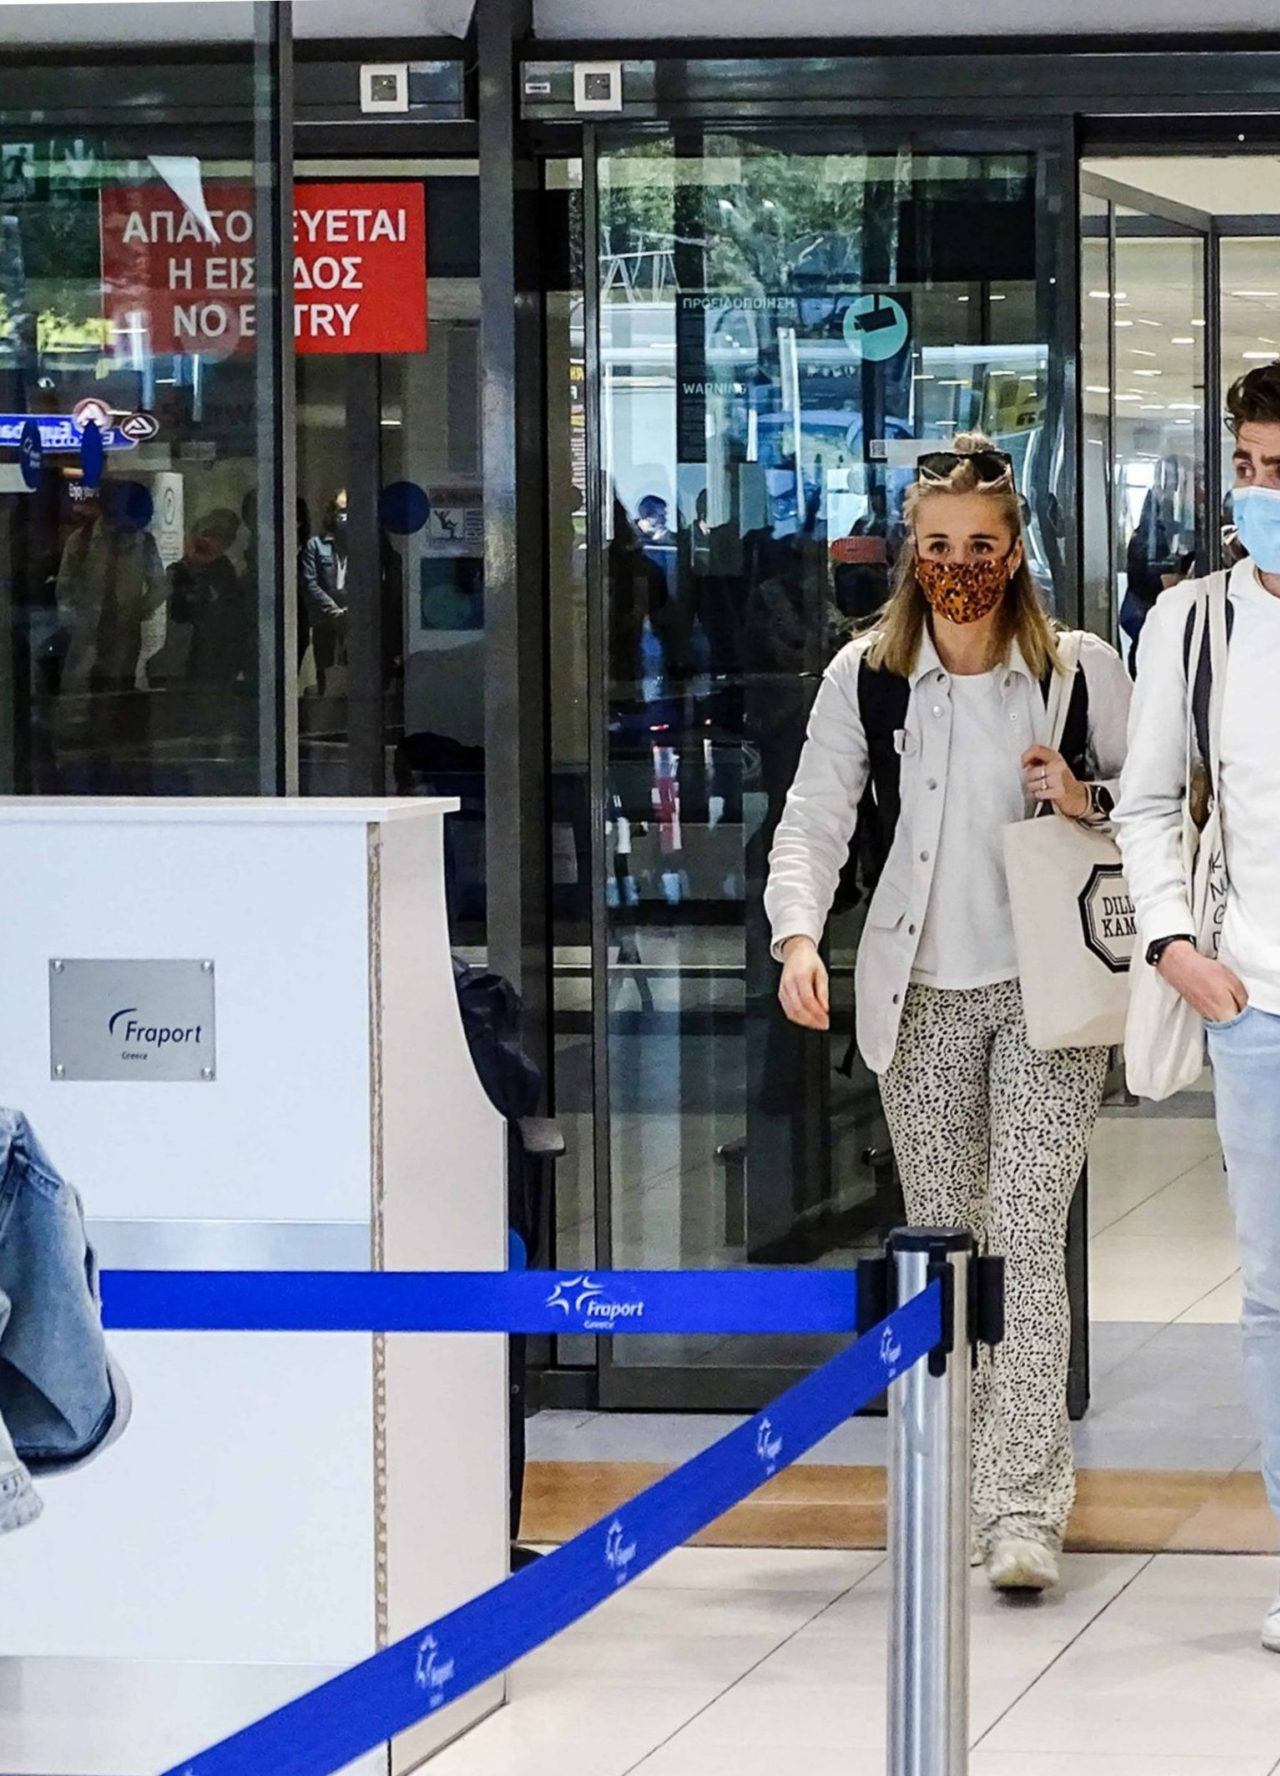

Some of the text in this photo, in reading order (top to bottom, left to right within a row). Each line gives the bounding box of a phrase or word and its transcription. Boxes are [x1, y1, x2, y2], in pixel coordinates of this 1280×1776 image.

[122, 209, 406, 243] ΑΠΑΟΥΕΤΑΙ
[168, 257, 363, 290] Η ΕΙΣΔΟΣ
[173, 303, 361, 337] NO ETRY
[682, 382, 747, 395] WARNING
[125, 1021, 202, 1047] Fraport
[587, 1301, 645, 1321] Fraport
